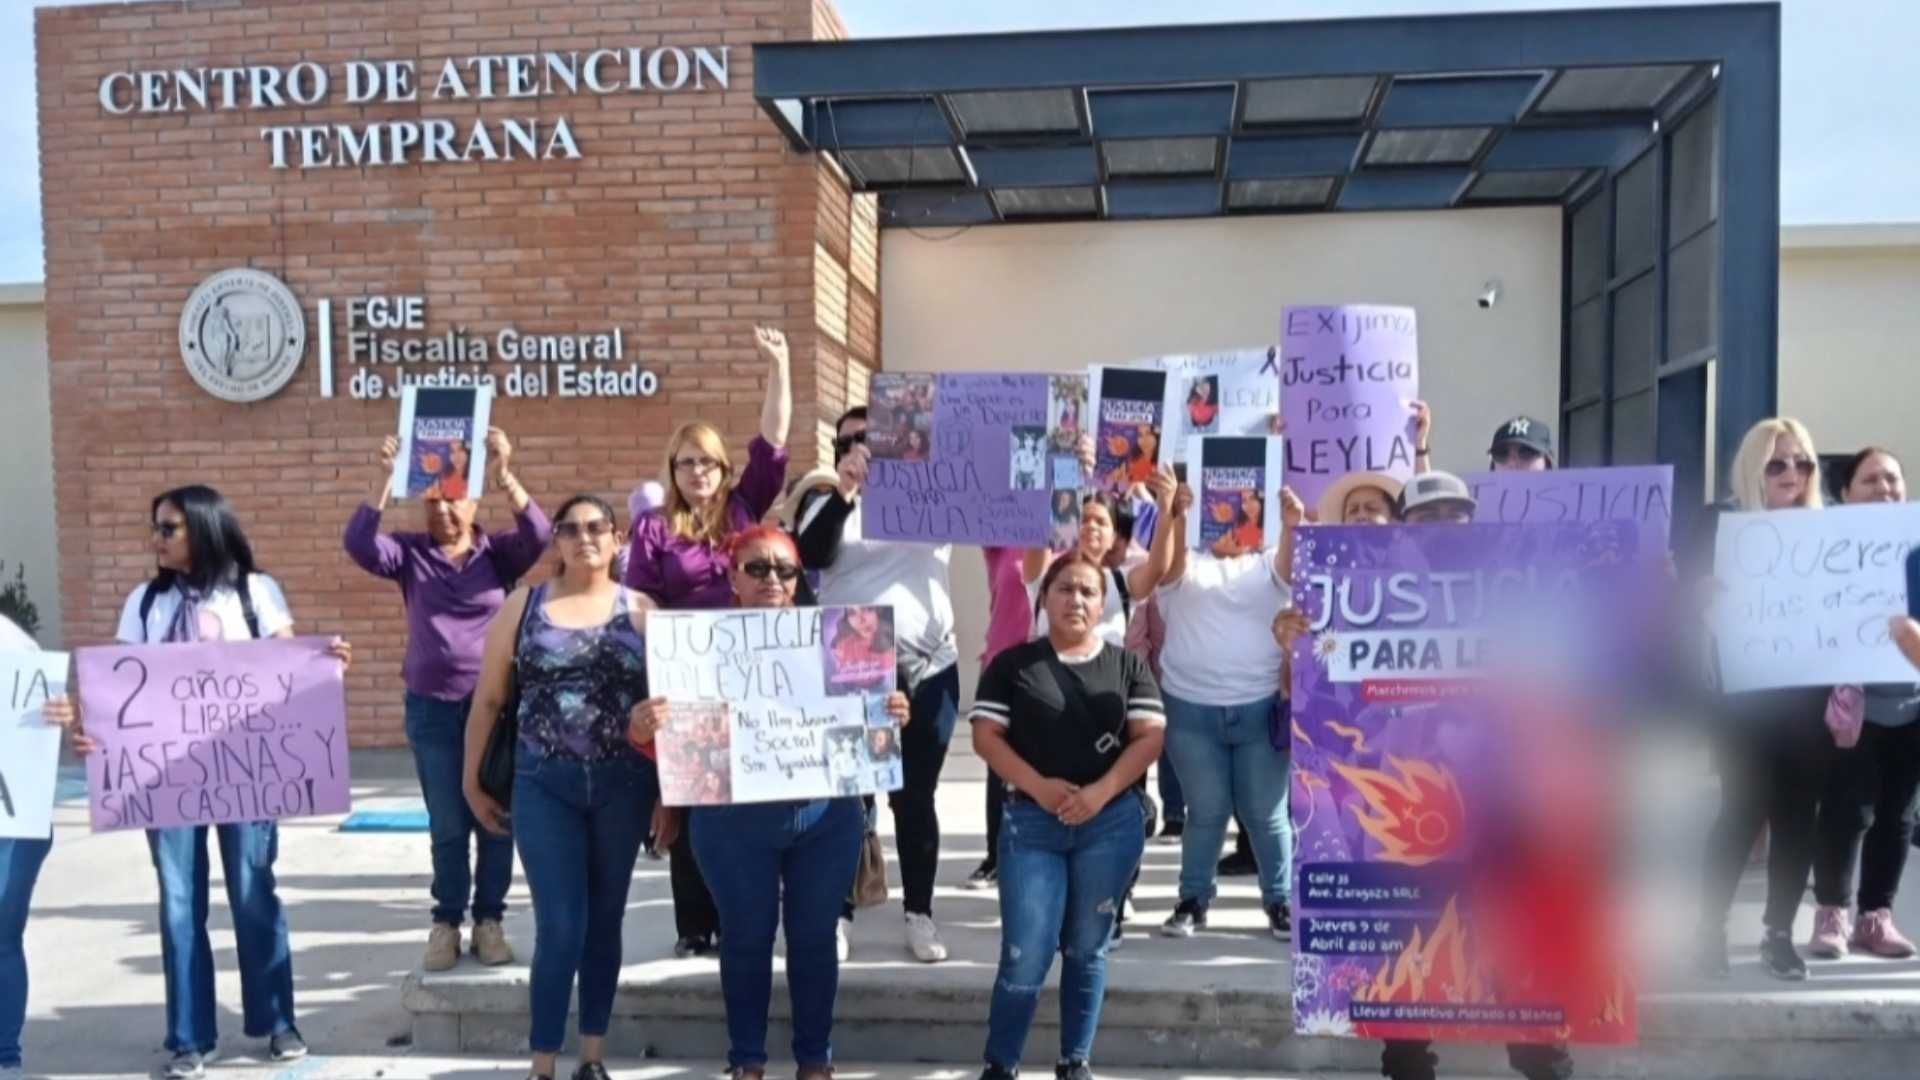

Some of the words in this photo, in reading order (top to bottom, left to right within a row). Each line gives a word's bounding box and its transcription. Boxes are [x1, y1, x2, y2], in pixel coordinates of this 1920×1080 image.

[99, 62, 328, 116] CENTRO
[345, 59, 417, 105] DE
[433, 45, 732, 100] ATENCION
[262, 117, 582, 169] TEMPRANA
[347, 297, 424, 329] FGJE
[347, 325, 489, 364] Fiscalía
[497, 328, 623, 361] General
[350, 367, 382, 398] de
[504, 364, 548, 396] del
[557, 363, 657, 396] Estado
[1284, 354, 1412, 386] Justicia
[1307, 398, 1371, 423] Para
[1285, 435, 1411, 474] LEYLA
[651, 609, 825, 661] JUSTICIA
[1350, 638, 1443, 671] PARA
[112, 655, 153, 730] 2
[171, 669, 260, 701] años
[737, 711, 761, 728] No
[314, 728, 336, 779] Y
[101, 793, 154, 829] SIN
[1309, 919, 1356, 933] Jueves
[1373, 921, 1390, 934] de
[1310, 937, 1344, 950] Abril
